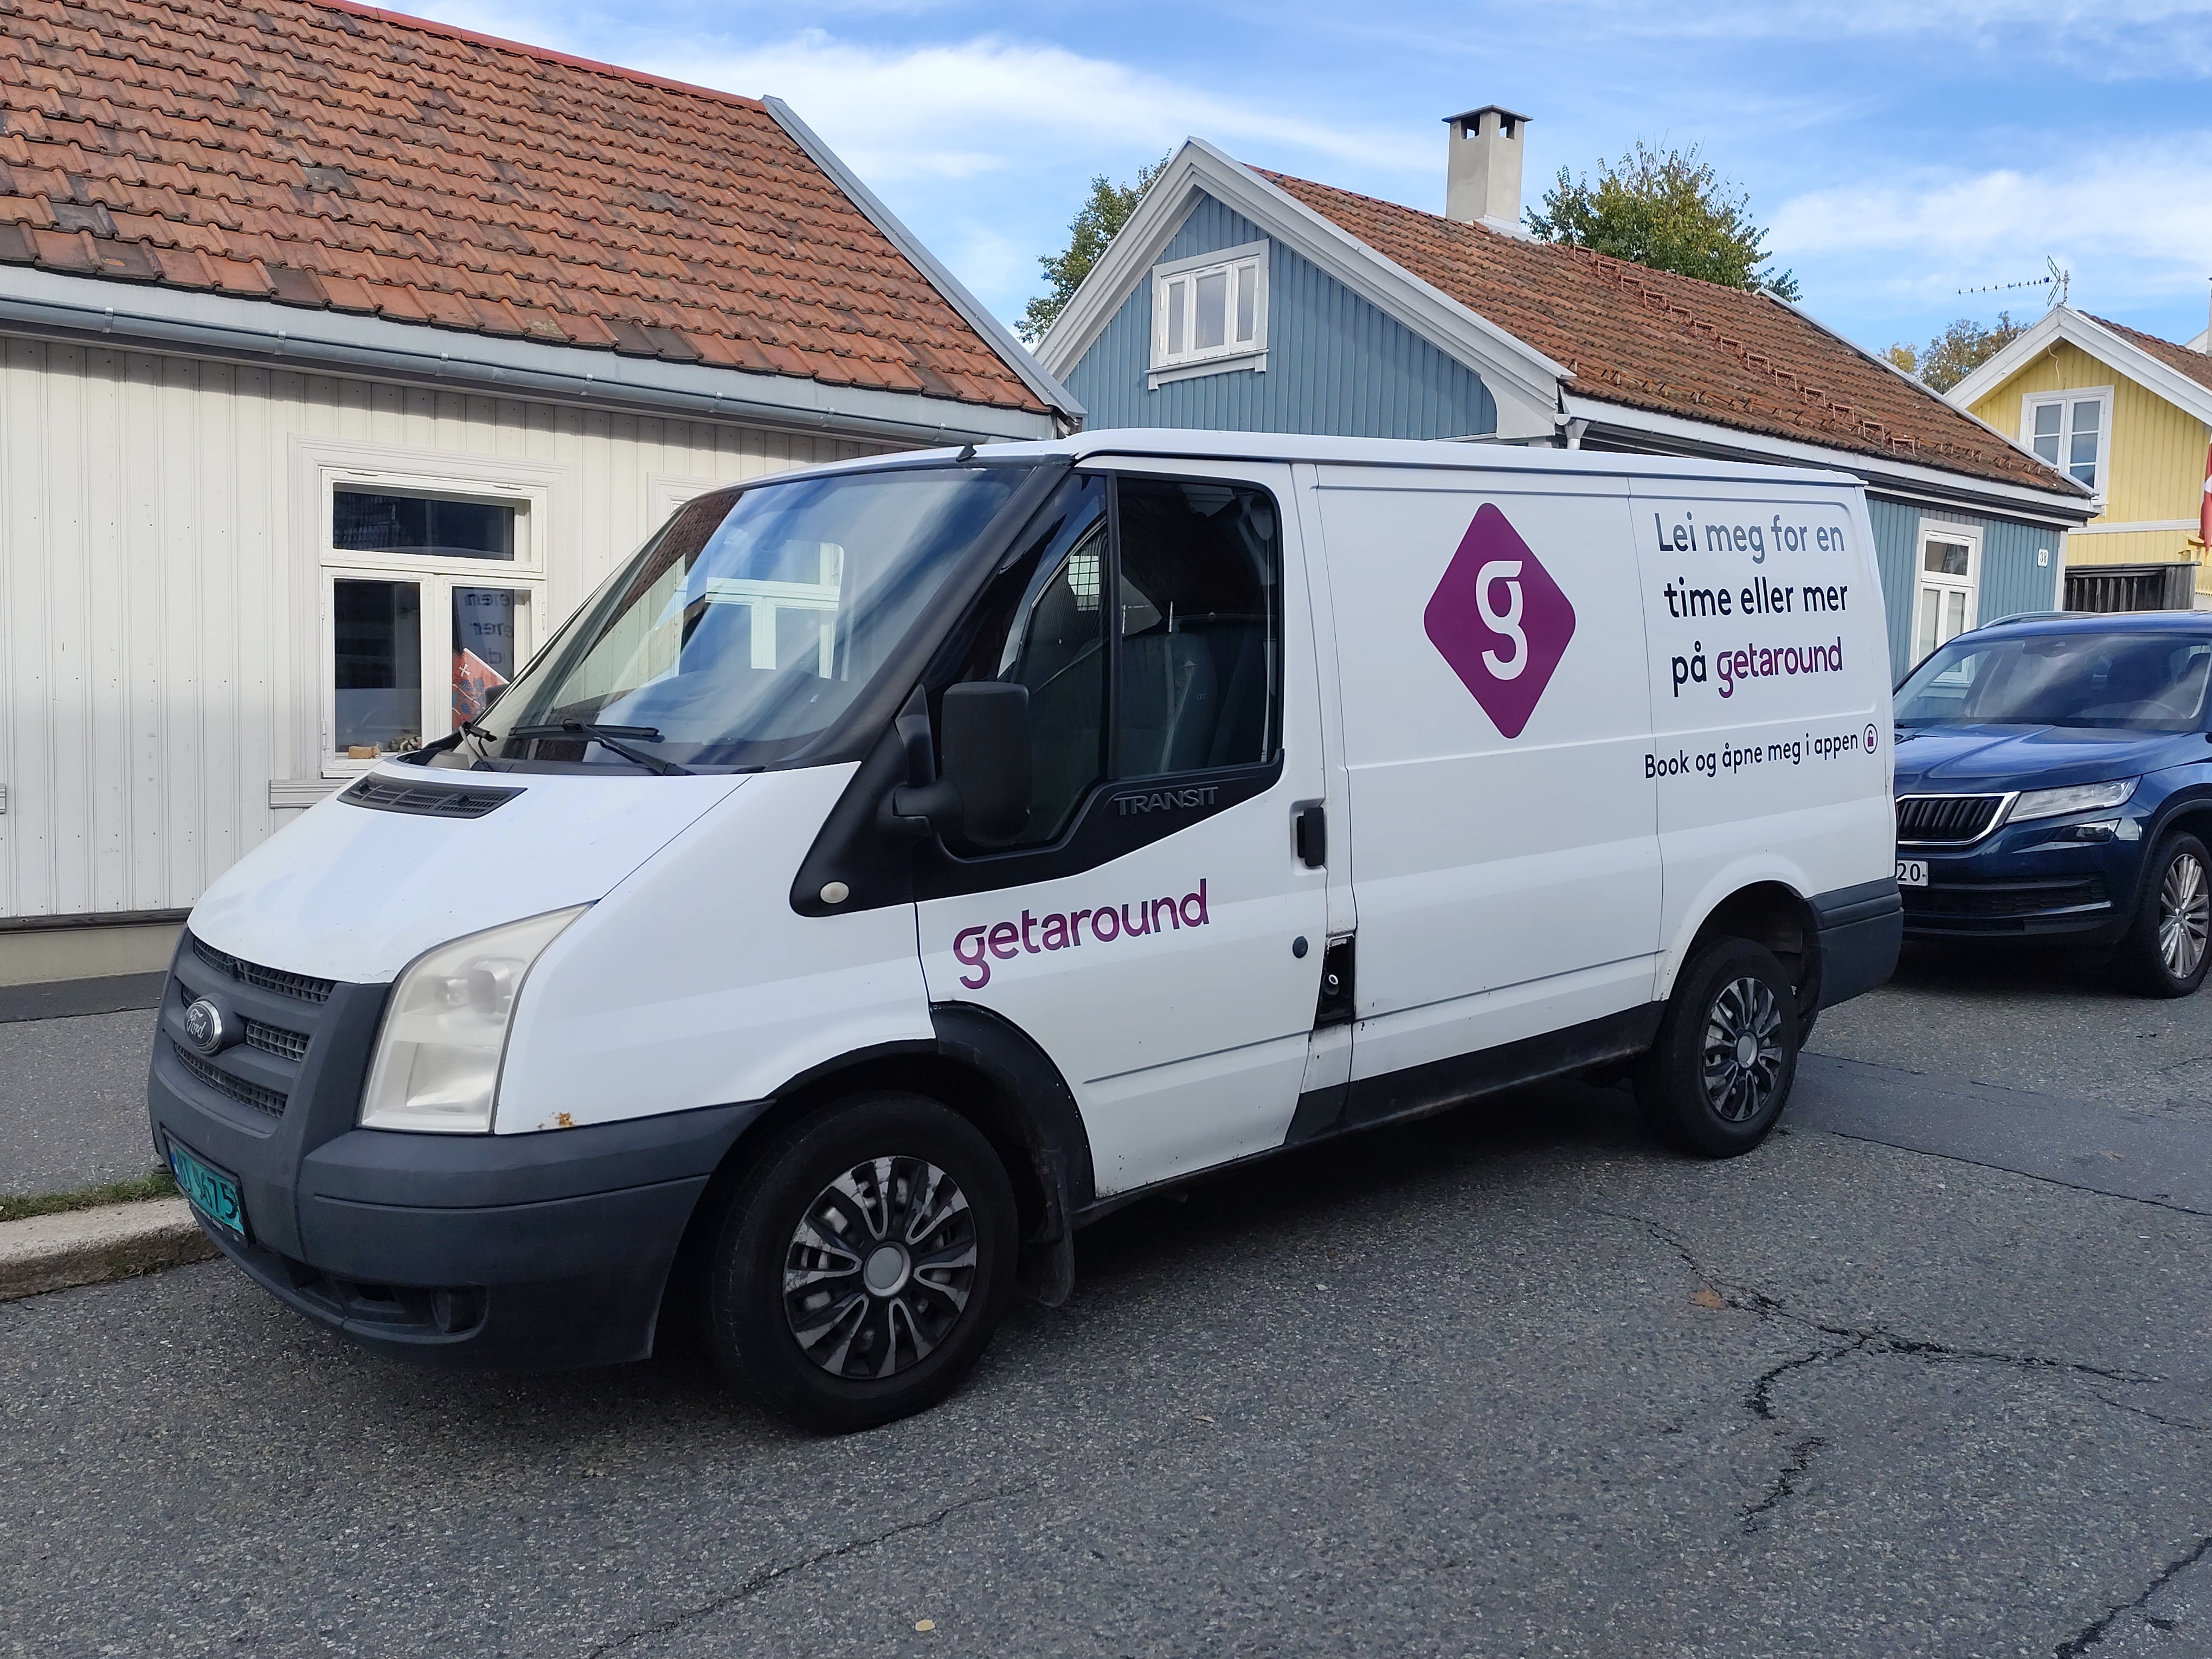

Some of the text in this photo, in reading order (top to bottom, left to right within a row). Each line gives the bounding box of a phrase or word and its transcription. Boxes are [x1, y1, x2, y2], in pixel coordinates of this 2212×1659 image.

[1655, 511, 1845, 564] Lei meg for en
[2040, 551, 2047, 563] 38
[1664, 576, 1848, 618] time eller mer
[1671, 636, 1843, 698] på getaround
[1645, 732, 1859, 779] Book og åpne meg i appen
[1114, 786, 1219, 815] TRANSIT
[953, 878, 1210, 989] getaround
[187, 1008, 207, 1039] Ford
